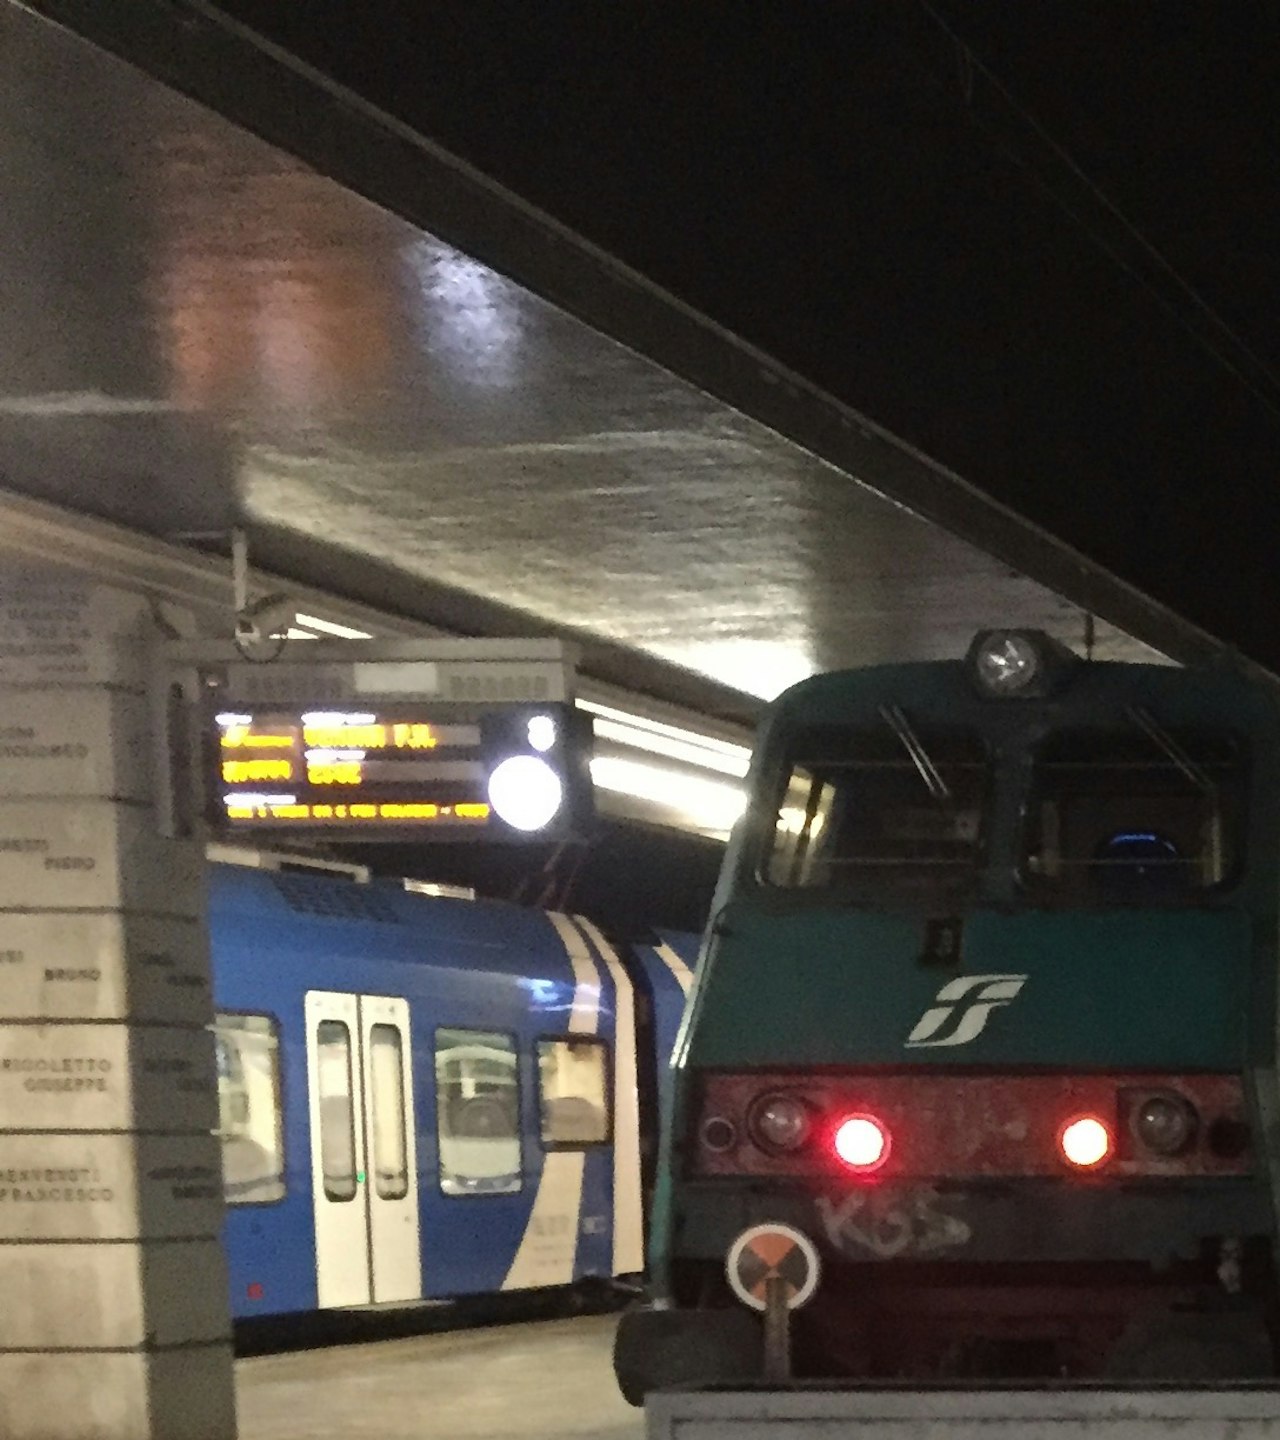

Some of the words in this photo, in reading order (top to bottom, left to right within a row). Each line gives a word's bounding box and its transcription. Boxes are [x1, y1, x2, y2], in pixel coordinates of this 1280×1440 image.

[44, 968, 101, 982] BRUNO
[2, 1058, 112, 1073] RIGOLETTO
[23, 1078, 107, 1092] GIUSEPPE
